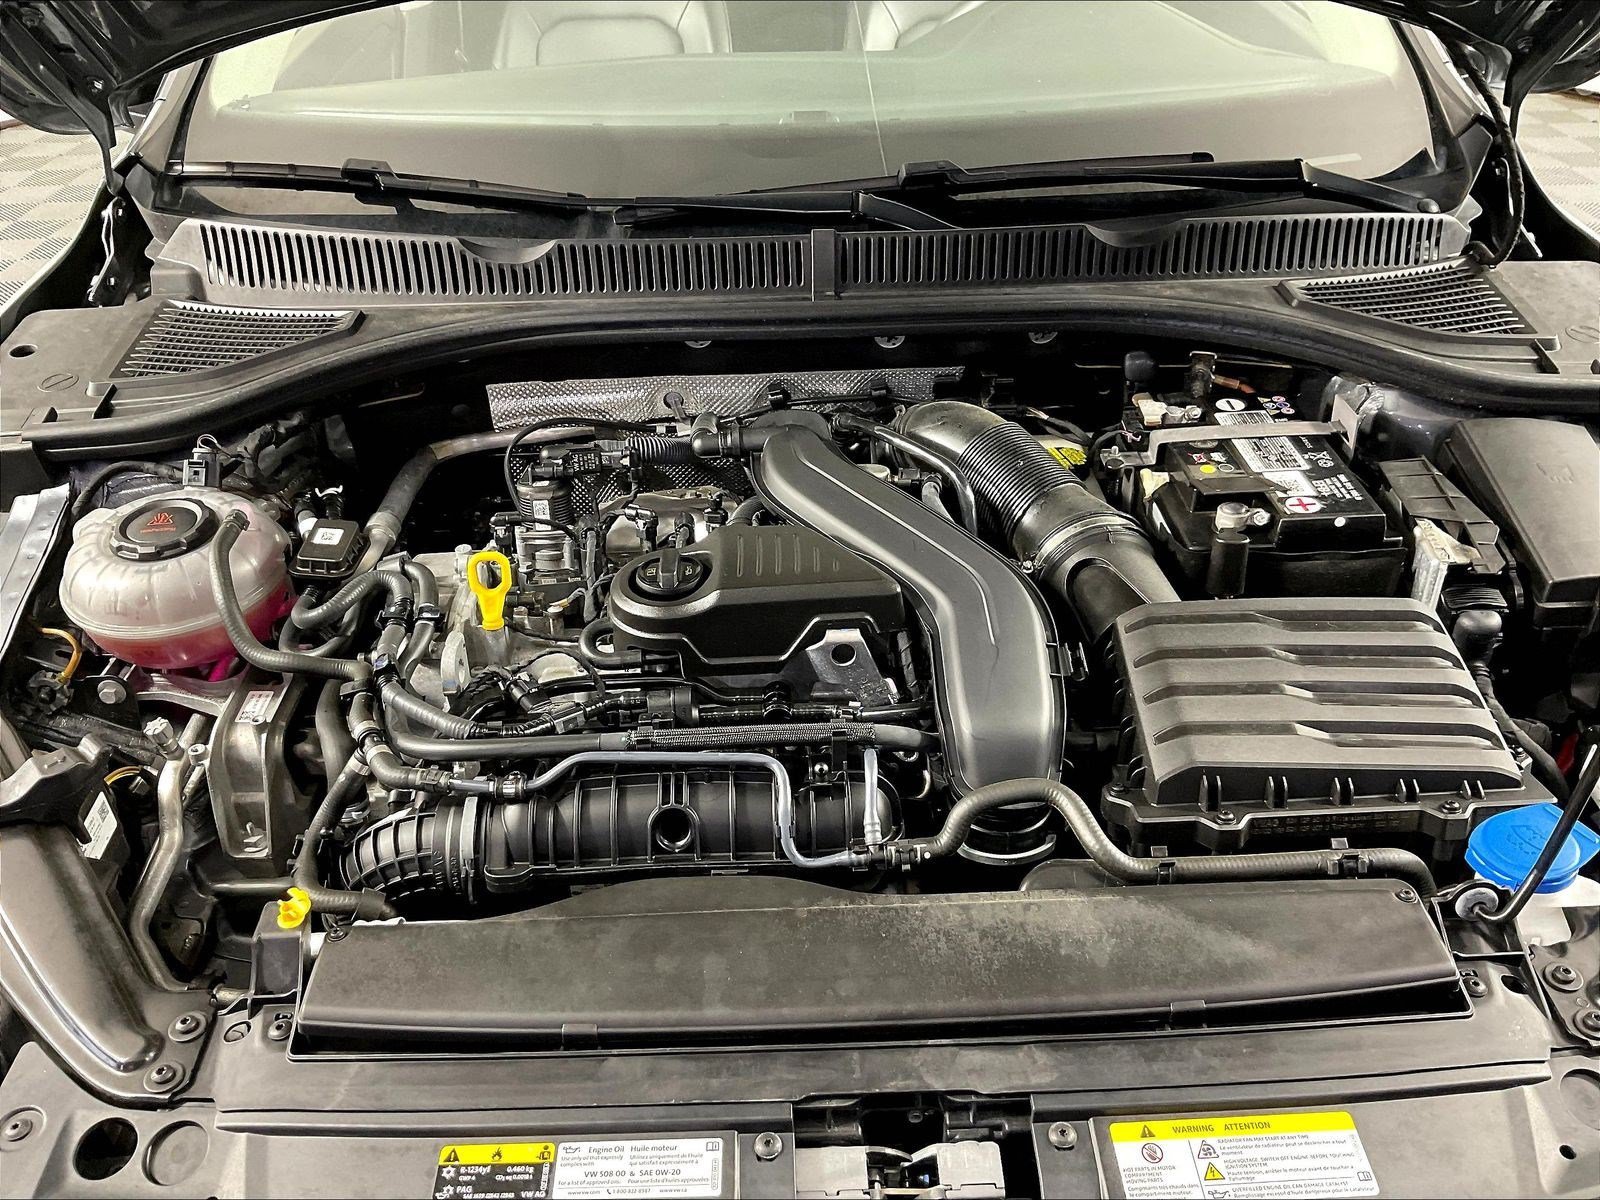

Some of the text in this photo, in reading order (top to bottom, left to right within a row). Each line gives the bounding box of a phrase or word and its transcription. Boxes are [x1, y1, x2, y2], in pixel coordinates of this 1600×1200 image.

[1172, 1122, 1271, 1134] WARNING ATTENTION
[588, 1146, 612, 1155] Engine
[460, 1165, 492, 1175] R-1234yf
